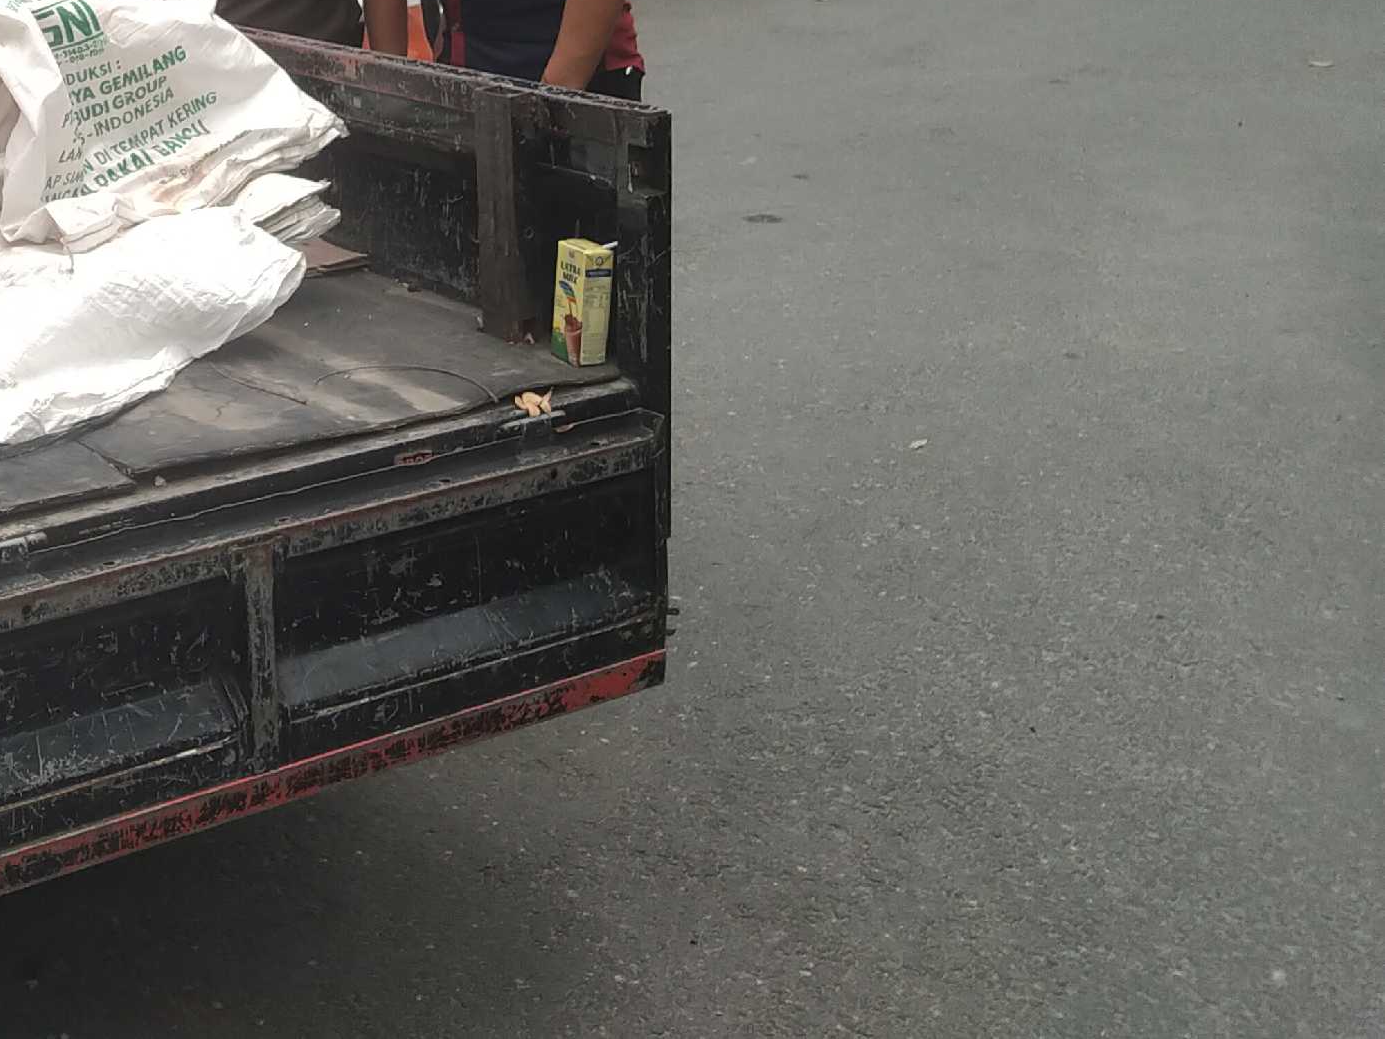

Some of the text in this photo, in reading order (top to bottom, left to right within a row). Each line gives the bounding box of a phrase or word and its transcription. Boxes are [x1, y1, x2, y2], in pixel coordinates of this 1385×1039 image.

[69, 45, 186, 106] YA GEMILANG
[112, 76, 167, 110] GROUP
[168, 91, 217, 128] KERING
